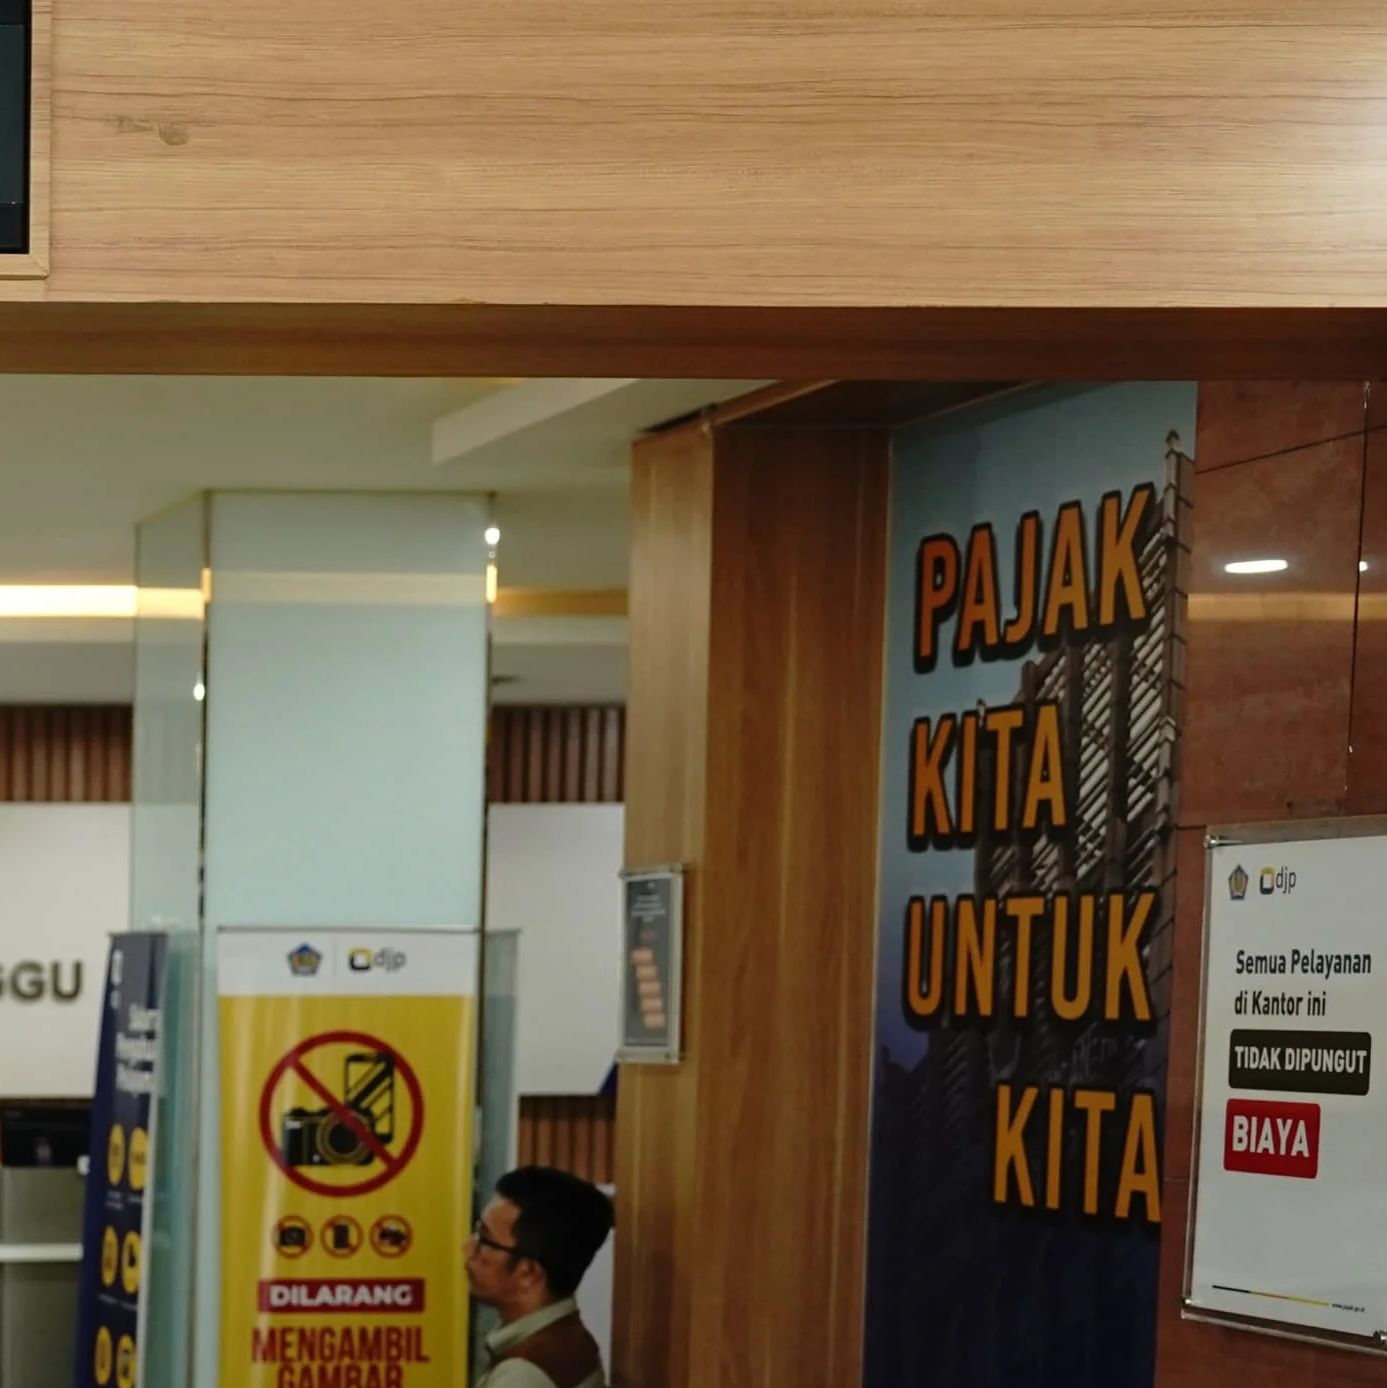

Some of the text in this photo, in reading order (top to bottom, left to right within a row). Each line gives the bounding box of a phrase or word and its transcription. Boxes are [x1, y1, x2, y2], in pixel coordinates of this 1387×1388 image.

[918, 484, 1155, 660] PAJAK
[911, 704, 1067, 837] KITA
[1276, 866, 1297, 894] djp
[373, 947, 407, 973] djp
[906, 892, 1154, 1021] UNTUK
[1235, 948, 1373, 980] Semua Pelayanan
[1234, 990, 1327, 1017] di Kantor ini
[1234, 1045, 1368, 1075] TIDAK DIPUNGUT
[993, 1085, 1162, 1222] KITA
[1232, 1115, 1310, 1158] BIAYA
[270, 1285, 413, 1306] DILARANG
[251, 1326, 430, 1363] MENGAMBIL
